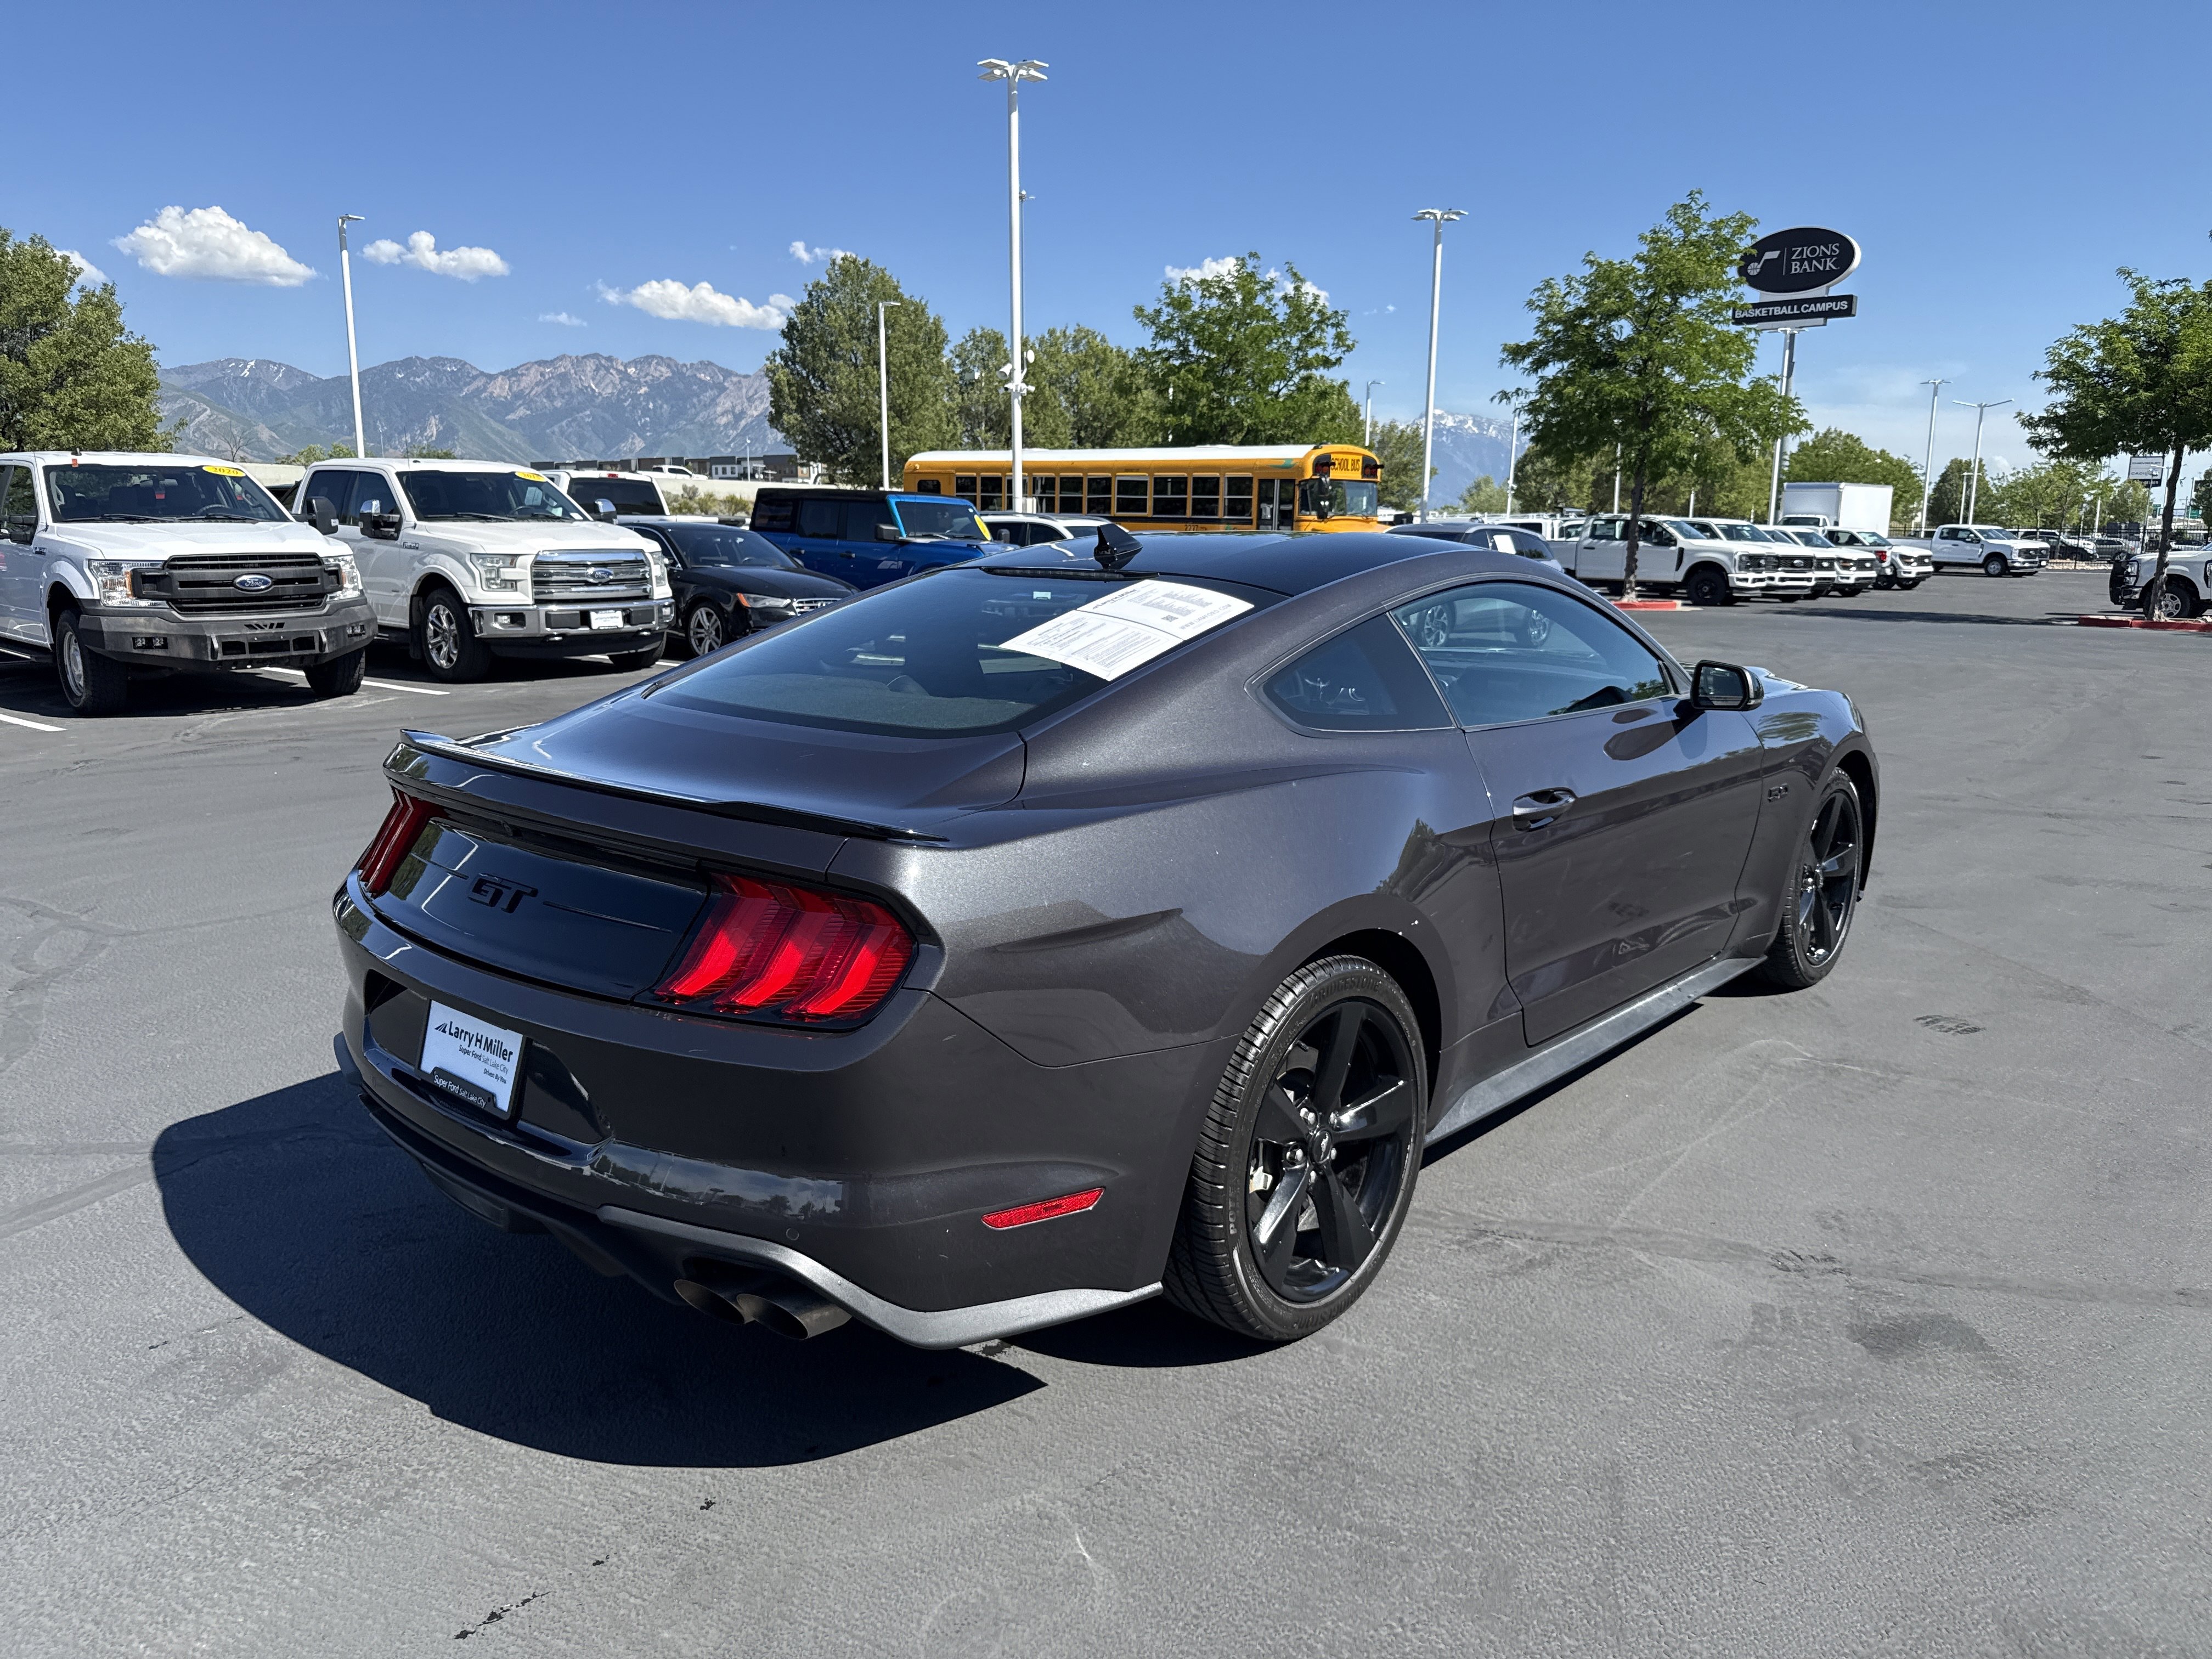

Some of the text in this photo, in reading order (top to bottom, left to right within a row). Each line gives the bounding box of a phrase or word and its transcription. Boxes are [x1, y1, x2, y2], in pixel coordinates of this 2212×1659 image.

[1791, 242, 1839, 259] ZIONS
[1790, 257, 1838, 275] BANK
[1734, 301, 1848, 319] BASKETBALL CAMPUS
[1331, 458, 1360, 472] SCHOOL BUS
[467, 873, 539, 914] GT
[448, 1021, 514, 1062] Larry H Miller
[459, 1045, 509, 1075] Super Ford Salt Lake City
[483, 1068, 495, 1079] Driven
[495, 1073, 500, 1082] By
[433, 1074, 487, 1109] Super Ford Salt Lake City
